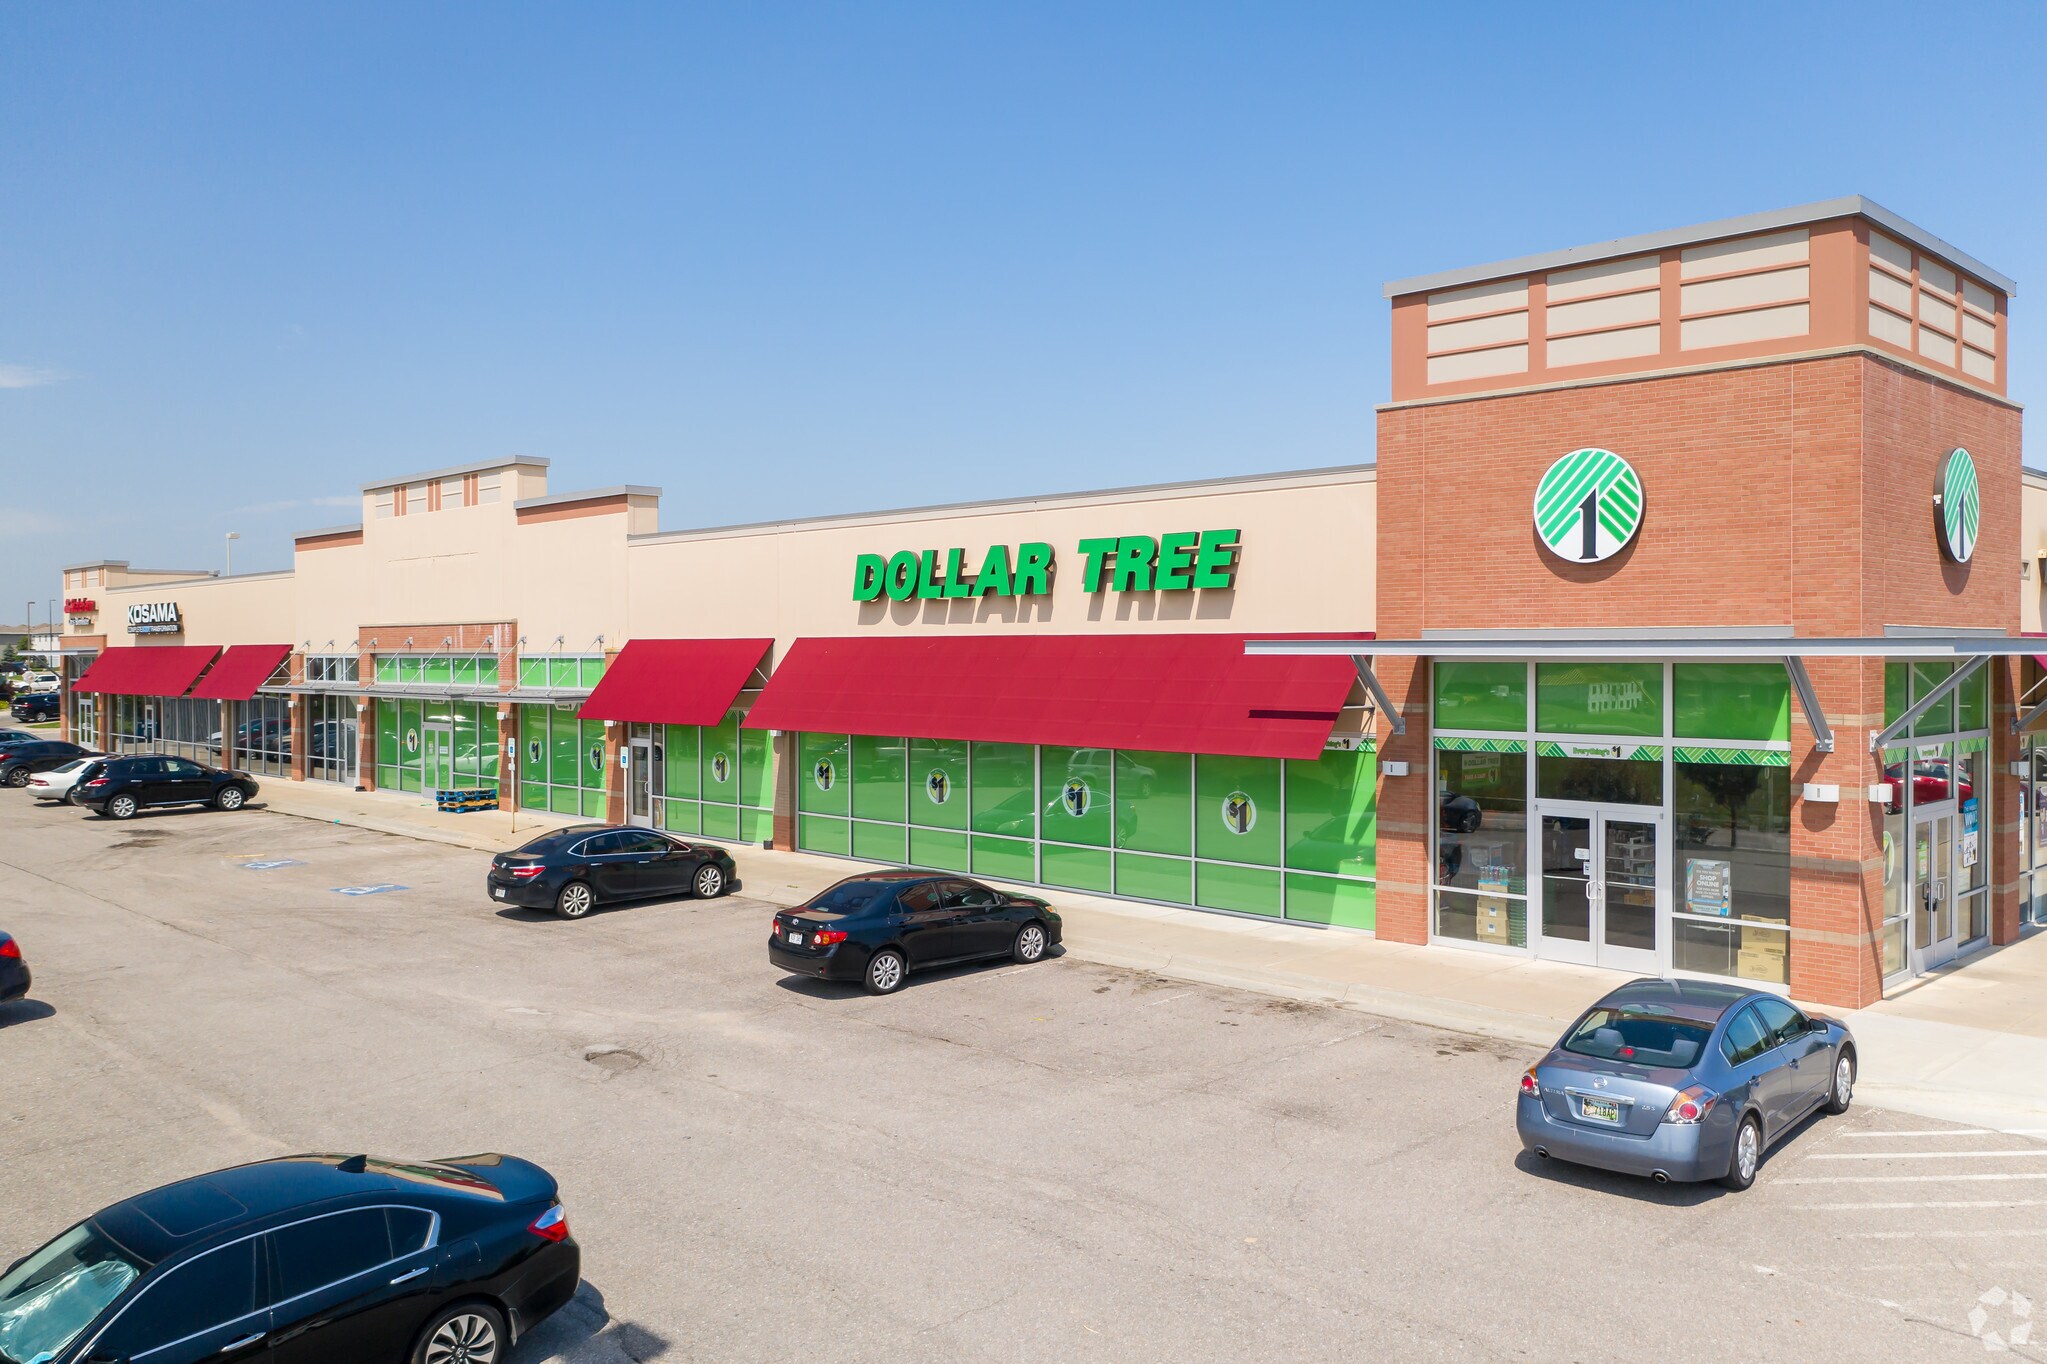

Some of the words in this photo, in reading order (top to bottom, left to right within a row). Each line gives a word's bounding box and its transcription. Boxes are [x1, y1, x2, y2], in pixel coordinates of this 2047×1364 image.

[852, 541, 1052, 602] DOLLAR
[1077, 528, 1241, 594] TREE
[127, 602, 178, 625] KOSAMA
[1067, 786, 1084, 816] $1
[1227, 801, 1248, 834] $1
[1543, 1087, 1564, 1096] ALTIMA
